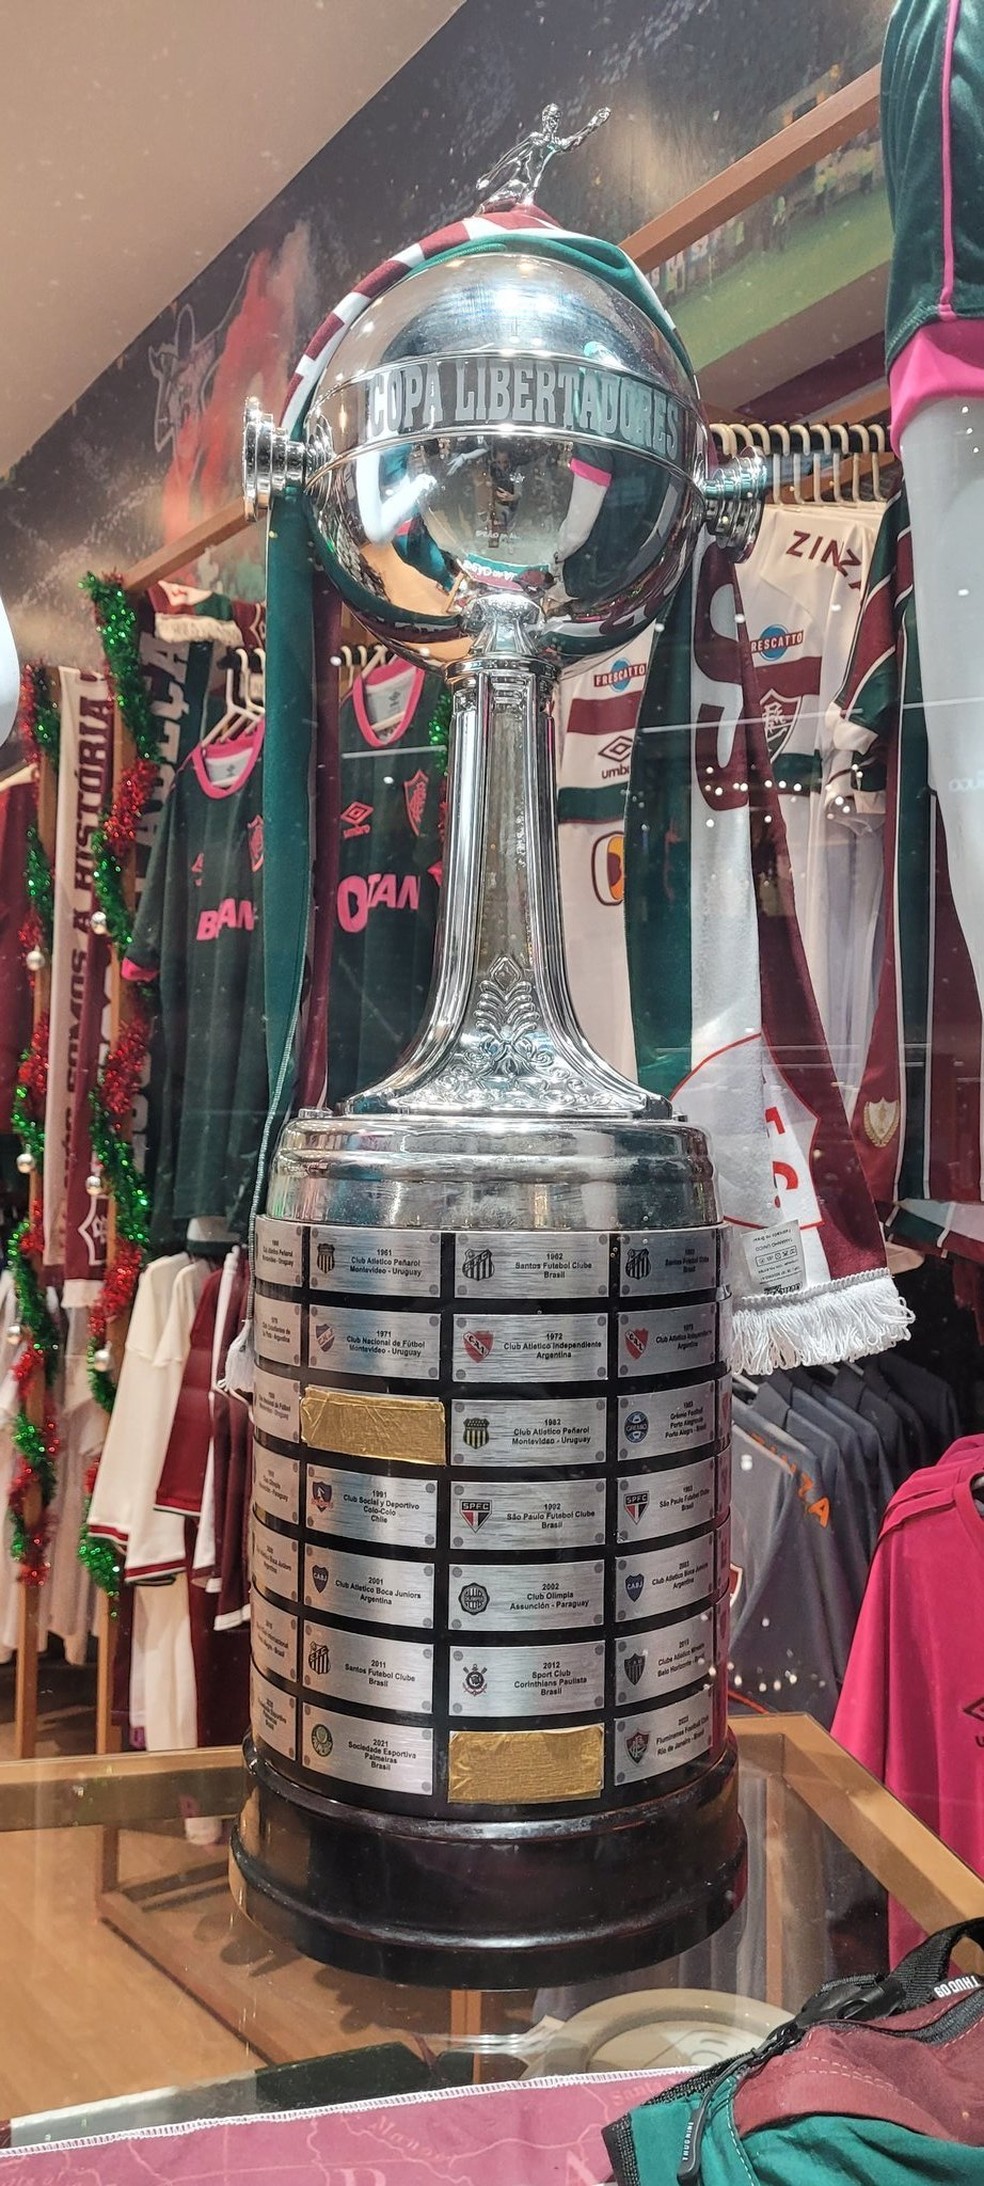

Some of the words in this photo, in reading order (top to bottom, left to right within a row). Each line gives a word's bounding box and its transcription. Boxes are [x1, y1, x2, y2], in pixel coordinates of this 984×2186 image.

[368, 362, 444, 436] COPA
[455, 358, 679, 457] LIBERTADORES
[751, 632, 803, 652] RESCATTO
[596, 664, 645, 686] FRESCATTO
[351, 1256, 365, 1264] Club
[393, 1258, 420, 1267] Peñarol
[572, 1261, 592, 1269] Clube
[350, 1265, 386, 1274] Montevideo
[392, 1267, 422, 1277] Uruguay
[544, 1271, 565, 1279] Brasil
[347, 1335, 360, 1343] Club
[362, 1337, 391, 1345] Nacional
[504, 1342, 521, 1350] Club
[552, 1341, 602, 1349] Independiente
[391, 1348, 421, 1357] Uruguay
[536, 1351, 571, 1360] Argentina
[514, 1428, 531, 1436] Club
[562, 1426, 589, 1434] Peñarol
[512, 1437, 555, 1445] Montevideo
[561, 1436, 591, 1445] Uruguay
[372, 1490, 387, 1498] 1991
[343, 1494, 357, 1502] Club
[359, 1496, 379, 1505] Social
[386, 1500, 419, 1510] Deportivo
[463, 1502, 489, 1510] SPFC
[363, 1505, 396, 1516] Colo-Colo
[546, 1511, 574, 1520] Futebol
[575, 1510, 595, 1518] Clube
[371, 1514, 388, 1523] Chile
[541, 1521, 563, 1529] Brasil
[368, 1577, 383, 1585] 2001
[652, 1577, 664, 1586] Club
[335, 1580, 349, 1588] Club
[376, 1587, 393, 1596] Boca
[395, 1590, 421, 1599] Juniors
[360, 1593, 392, 1605] Argentina
[546, 1591, 574, 1600] Olimpia
[556, 1600, 590, 1609] Paraguay
[371, 1660, 386, 1668] 2011
[543, 1661, 560, 1669] 2012
[345, 1663, 366, 1674] Santos
[368, 1668, 393, 1679] Futebol
[395, 1672, 415, 1682] Clube
[532, 1671, 552, 1680] Sport
[554, 1669, 570, 1678] Club
[368, 1677, 388, 1687] Brasil
[514, 1680, 557, 1688] Corinthians
[559, 1677, 587, 1686] Paulista
[541, 1687, 562, 1696] Brasil
[373, 1739, 388, 1747] 2021
[348, 1741, 381, 1754] Sociedade
[383, 1748, 416, 1759] Esportiva
[364, 1752, 397, 1764] Palmeiras
[371, 1761, 391, 1771] Brasil
